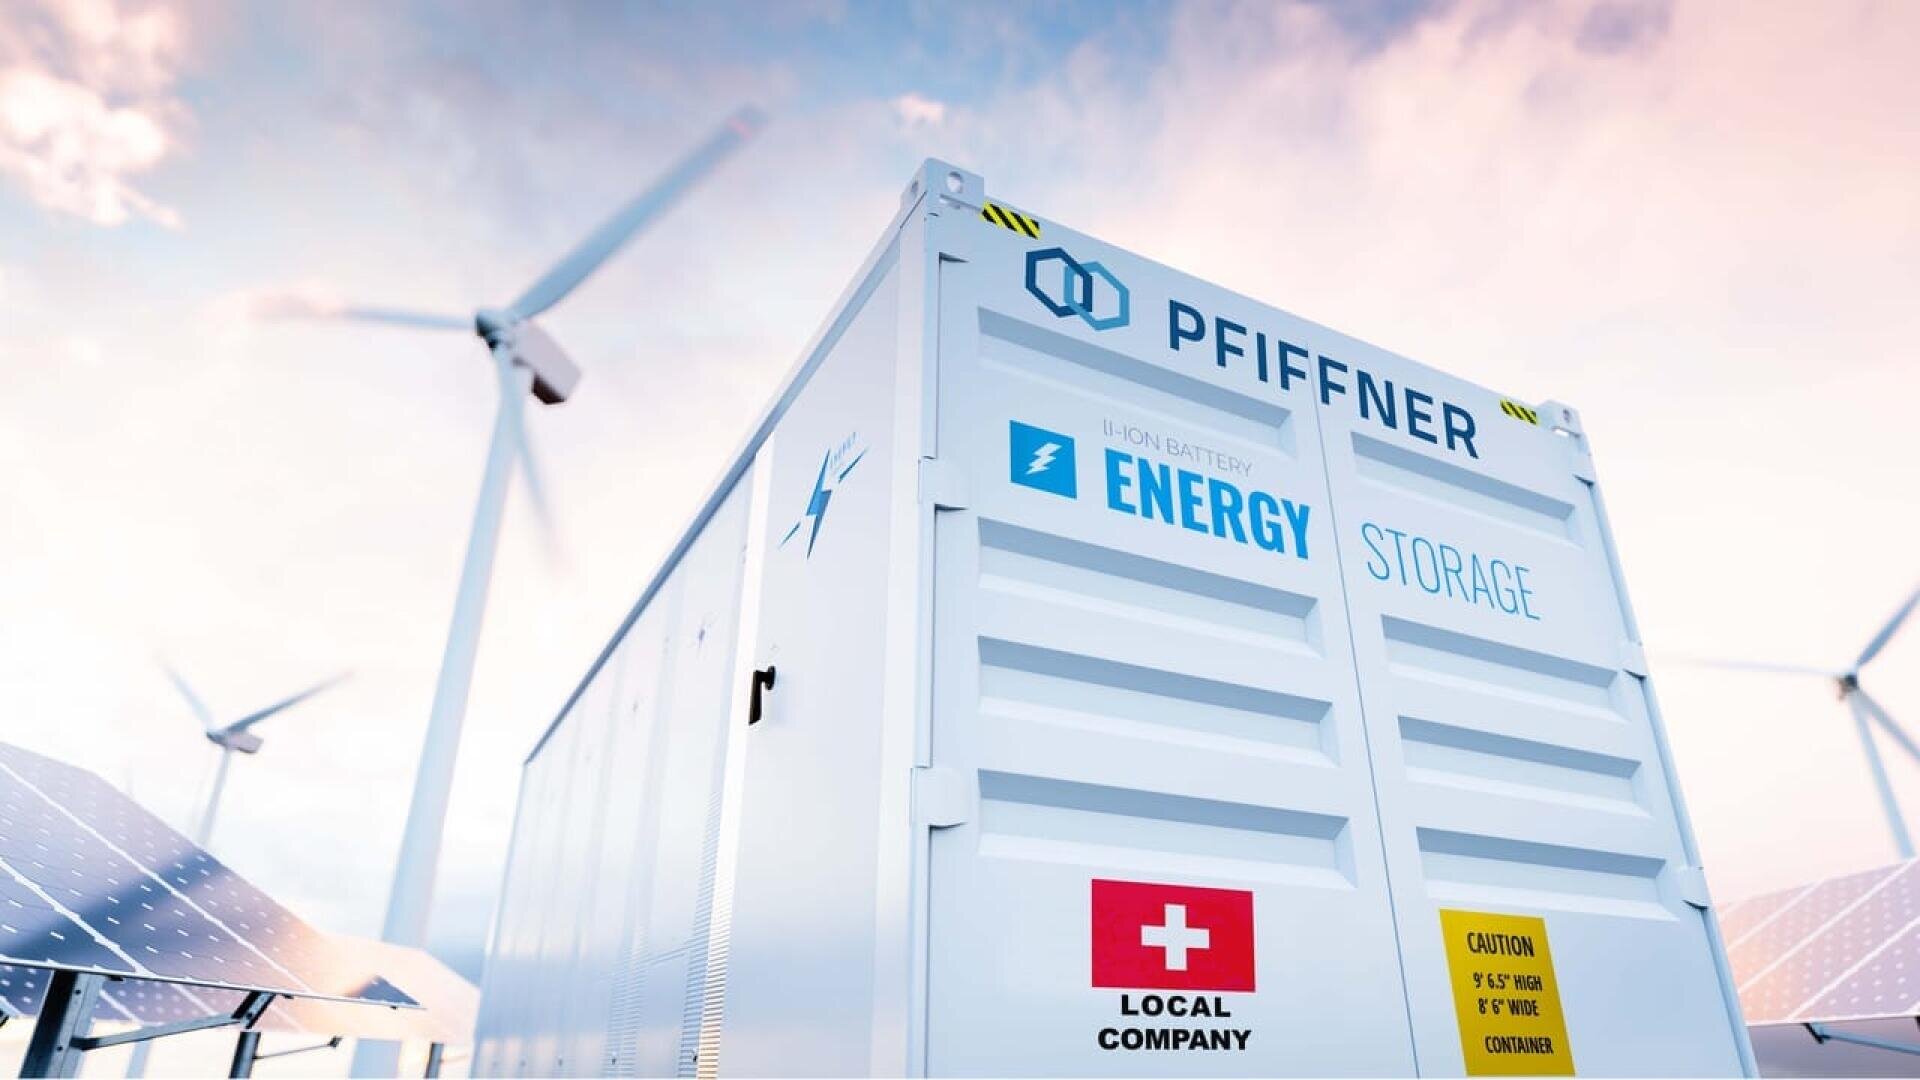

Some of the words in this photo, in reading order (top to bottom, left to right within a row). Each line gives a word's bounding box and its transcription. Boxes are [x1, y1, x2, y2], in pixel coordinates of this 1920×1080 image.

[1169, 299, 1478, 459] PFIFFNER
[1167, 437, 1253, 477] BATTERY
[1104, 448, 1311, 559] ENERGY
[1361, 522, 1540, 621] STORAGE
[1467, 932, 1535, 957] CAUTION
[1514, 974, 1543, 992] HIGH
[1121, 994, 1231, 1018] LOCAL
[1507, 999, 1540, 1017] WIDE
[1097, 1028, 1252, 1051] COMPANY
[1484, 1035, 1555, 1055] CONTAINER
